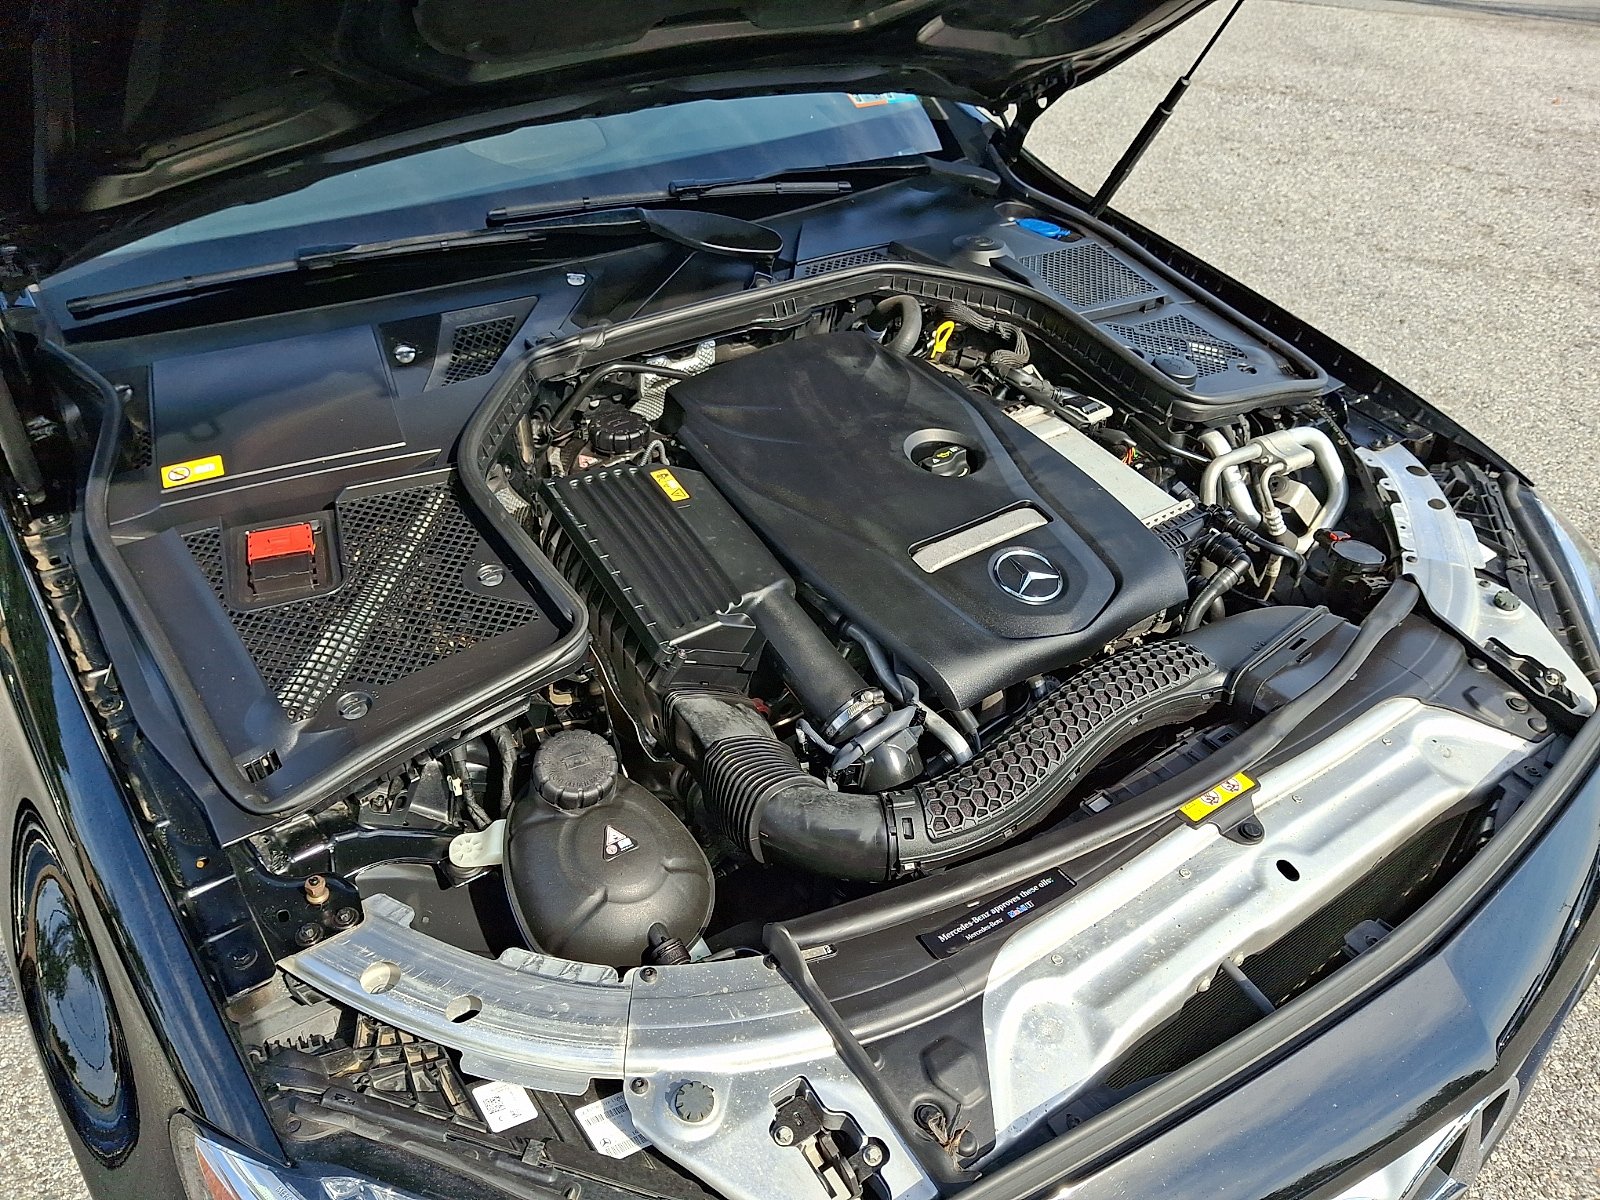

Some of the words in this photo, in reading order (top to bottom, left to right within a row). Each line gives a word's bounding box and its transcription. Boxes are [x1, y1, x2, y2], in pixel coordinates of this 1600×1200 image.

[937, 911, 991, 943] Mercedes-Benz
[990, 896, 1021, 916] approves
[1019, 884, 1040, 899] these
[1038, 877, 1055, 889] oils:
[965, 917, 1004, 941] Mercedes-Benz
